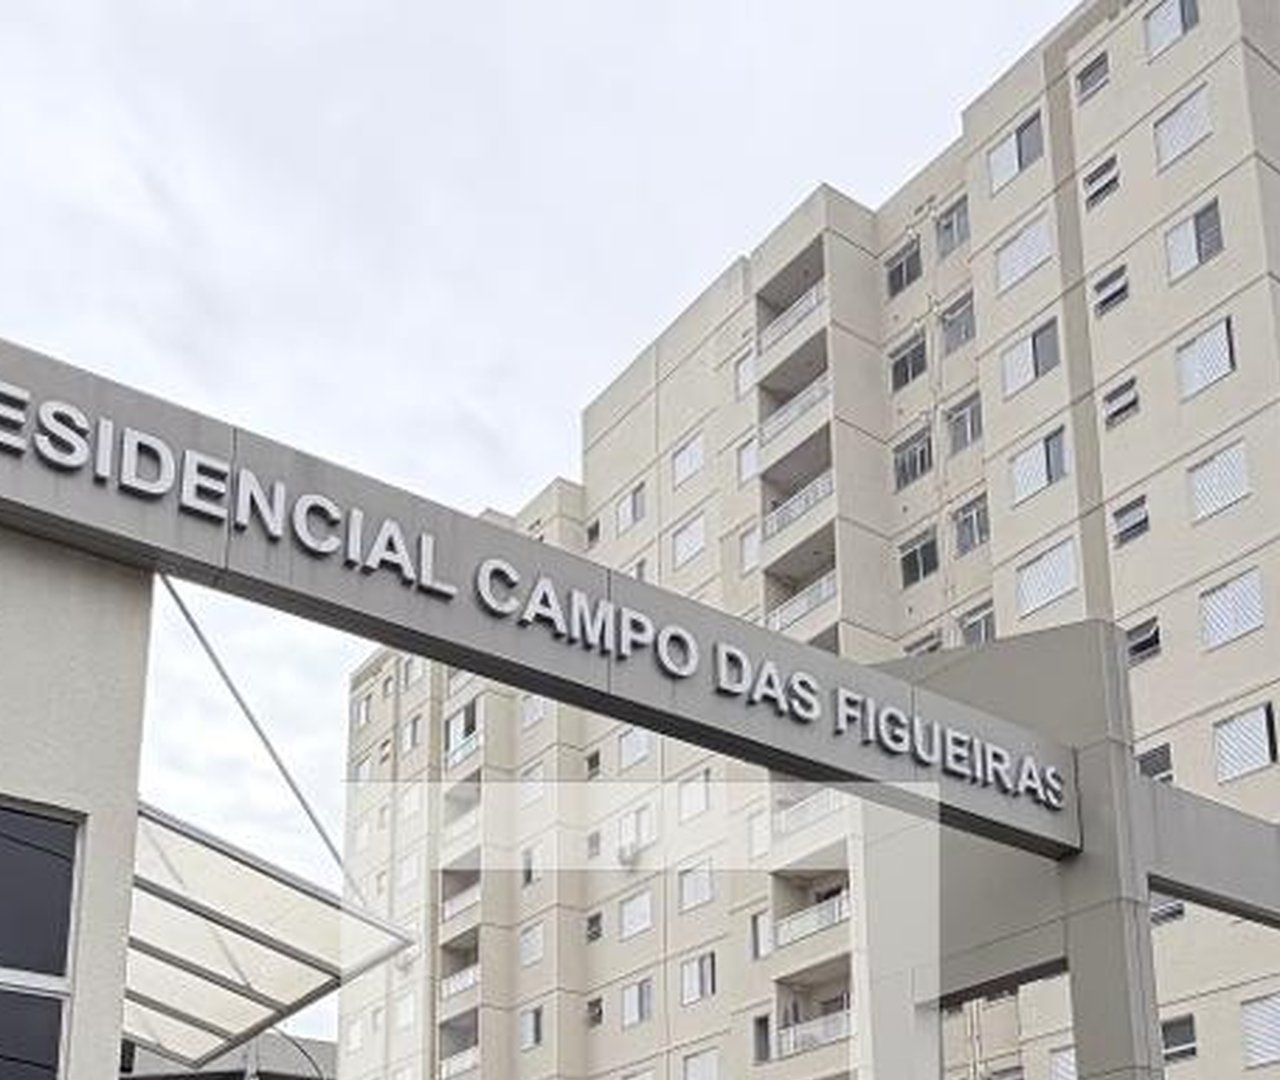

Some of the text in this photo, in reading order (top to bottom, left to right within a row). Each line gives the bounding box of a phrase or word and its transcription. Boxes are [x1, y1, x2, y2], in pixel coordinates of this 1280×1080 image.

[473, 556, 701, 680] CAMPO
[712, 640, 821, 723] DAS
[830, 685, 1068, 811] FIGUEIRAS
